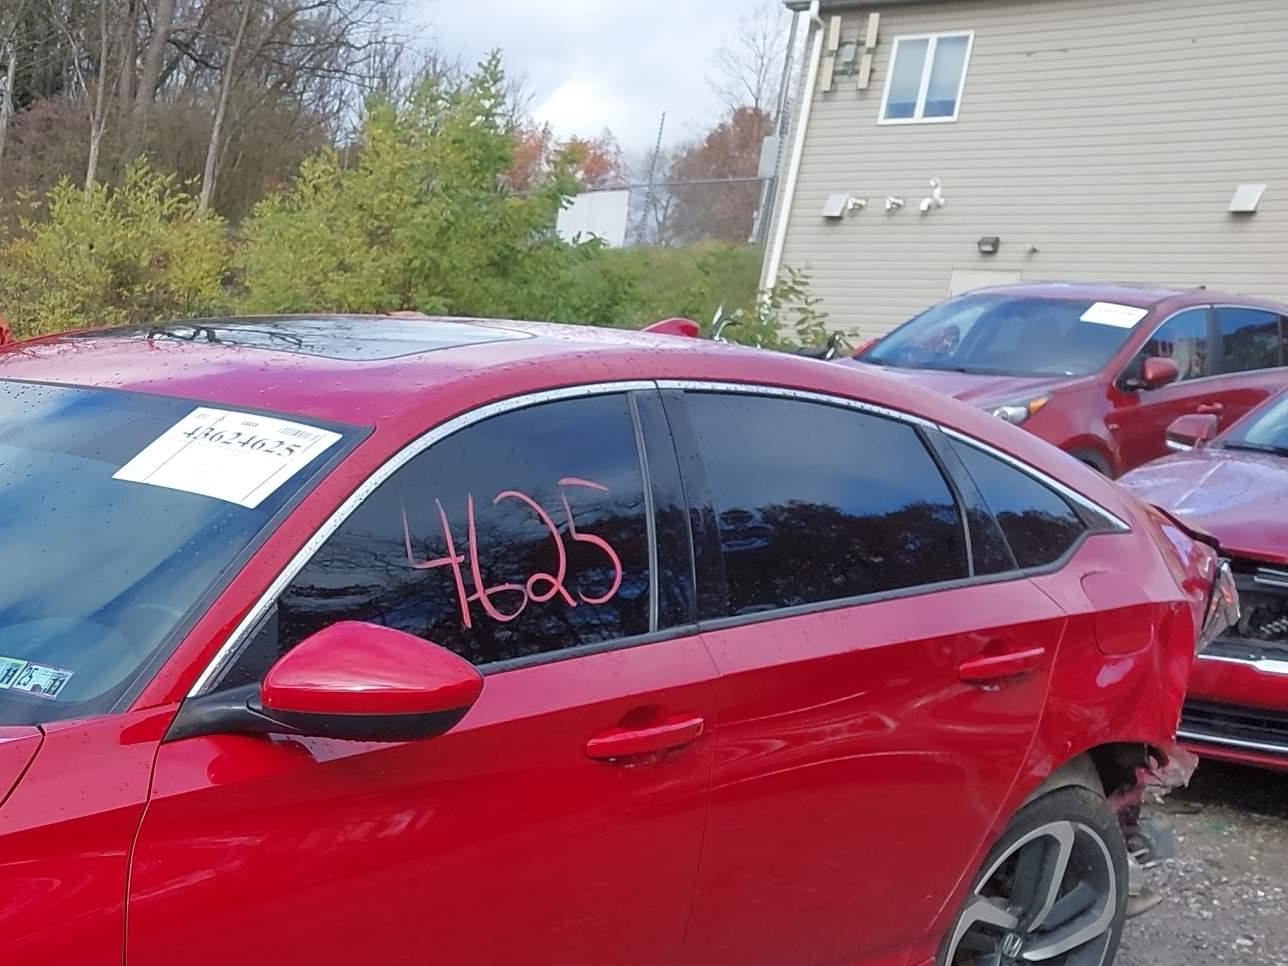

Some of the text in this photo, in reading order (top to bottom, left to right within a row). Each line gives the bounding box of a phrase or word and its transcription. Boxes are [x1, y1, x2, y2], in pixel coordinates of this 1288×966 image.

[183, 425, 302, 457] 43624625
[402, 476, 623, 629] 4625
[0, 667, 18, 685] 11
[16, 667, 39, 686] 25
